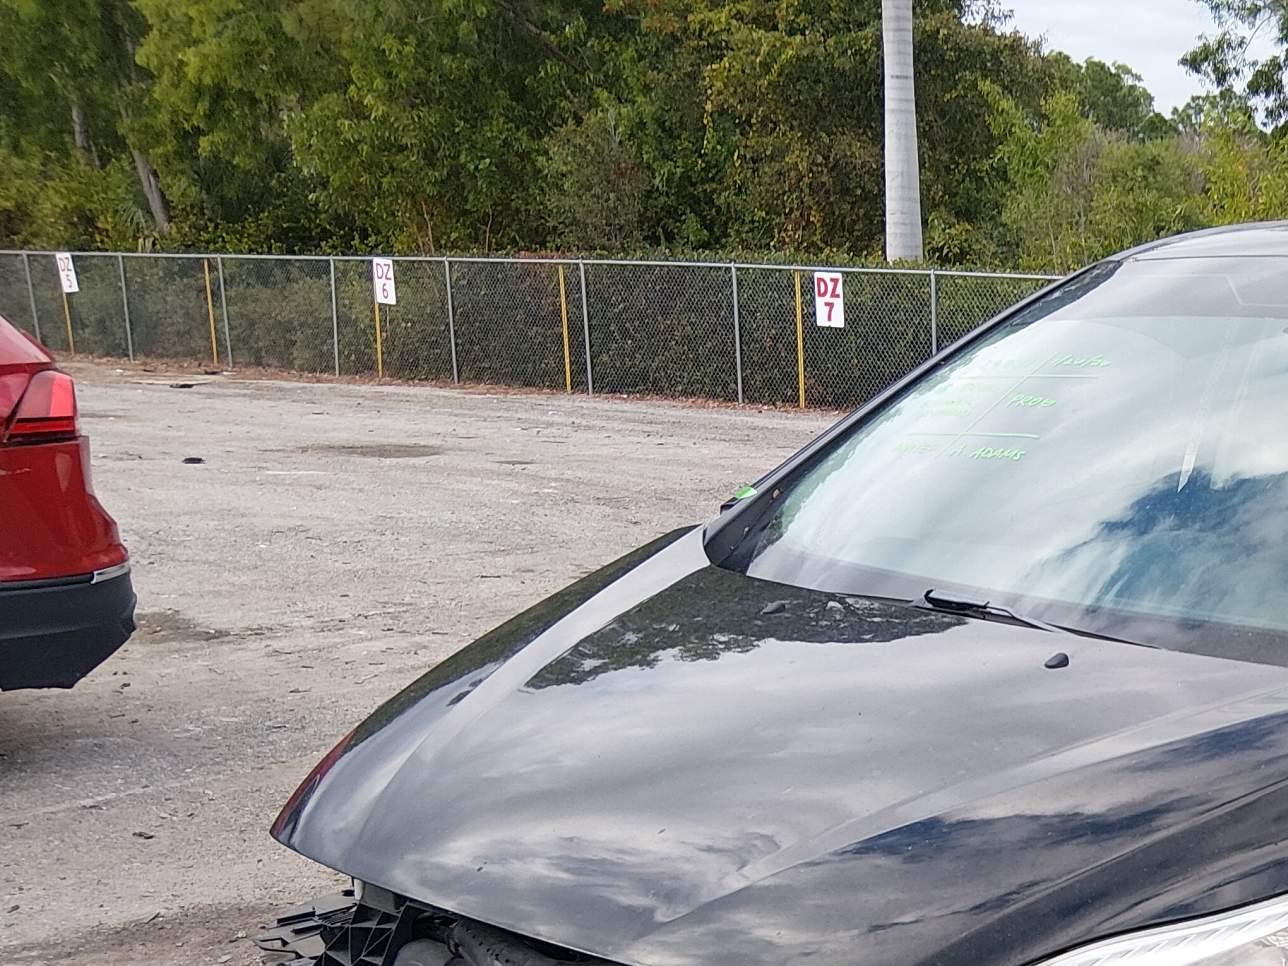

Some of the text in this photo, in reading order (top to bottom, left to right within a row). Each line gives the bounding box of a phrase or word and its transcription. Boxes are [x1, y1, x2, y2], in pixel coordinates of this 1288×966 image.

[58, 256, 73, 272] DZ
[375, 262, 392, 280] DZ
[382, 283, 389, 299] 6
[816, 277, 840, 298] DZ
[824, 302, 834, 321] 7
[968, 446, 1026, 462] ADAMS
